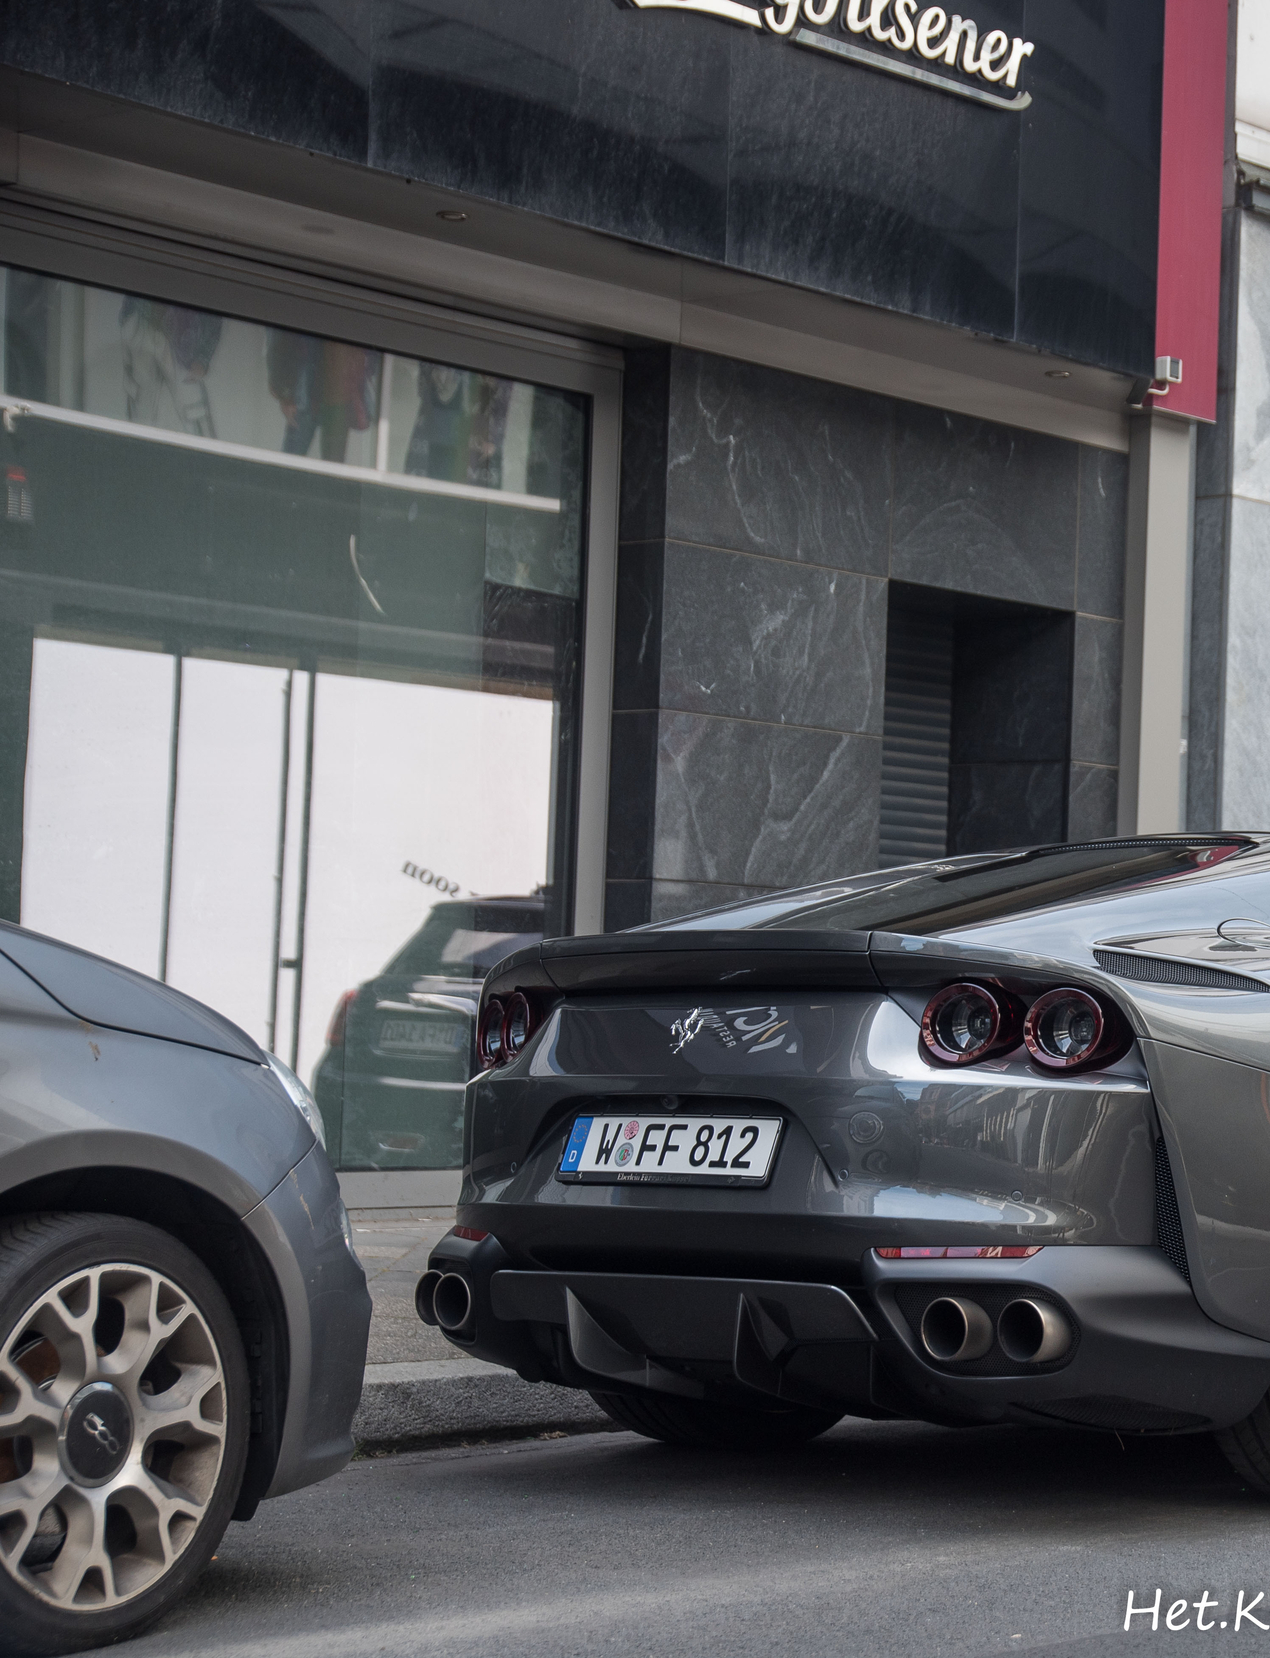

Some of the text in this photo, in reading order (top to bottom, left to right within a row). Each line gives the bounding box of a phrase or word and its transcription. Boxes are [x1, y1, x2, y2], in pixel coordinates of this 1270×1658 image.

[568, 1150, 577, 1163] D
[595, 1123, 760, 1169] W FF 812
